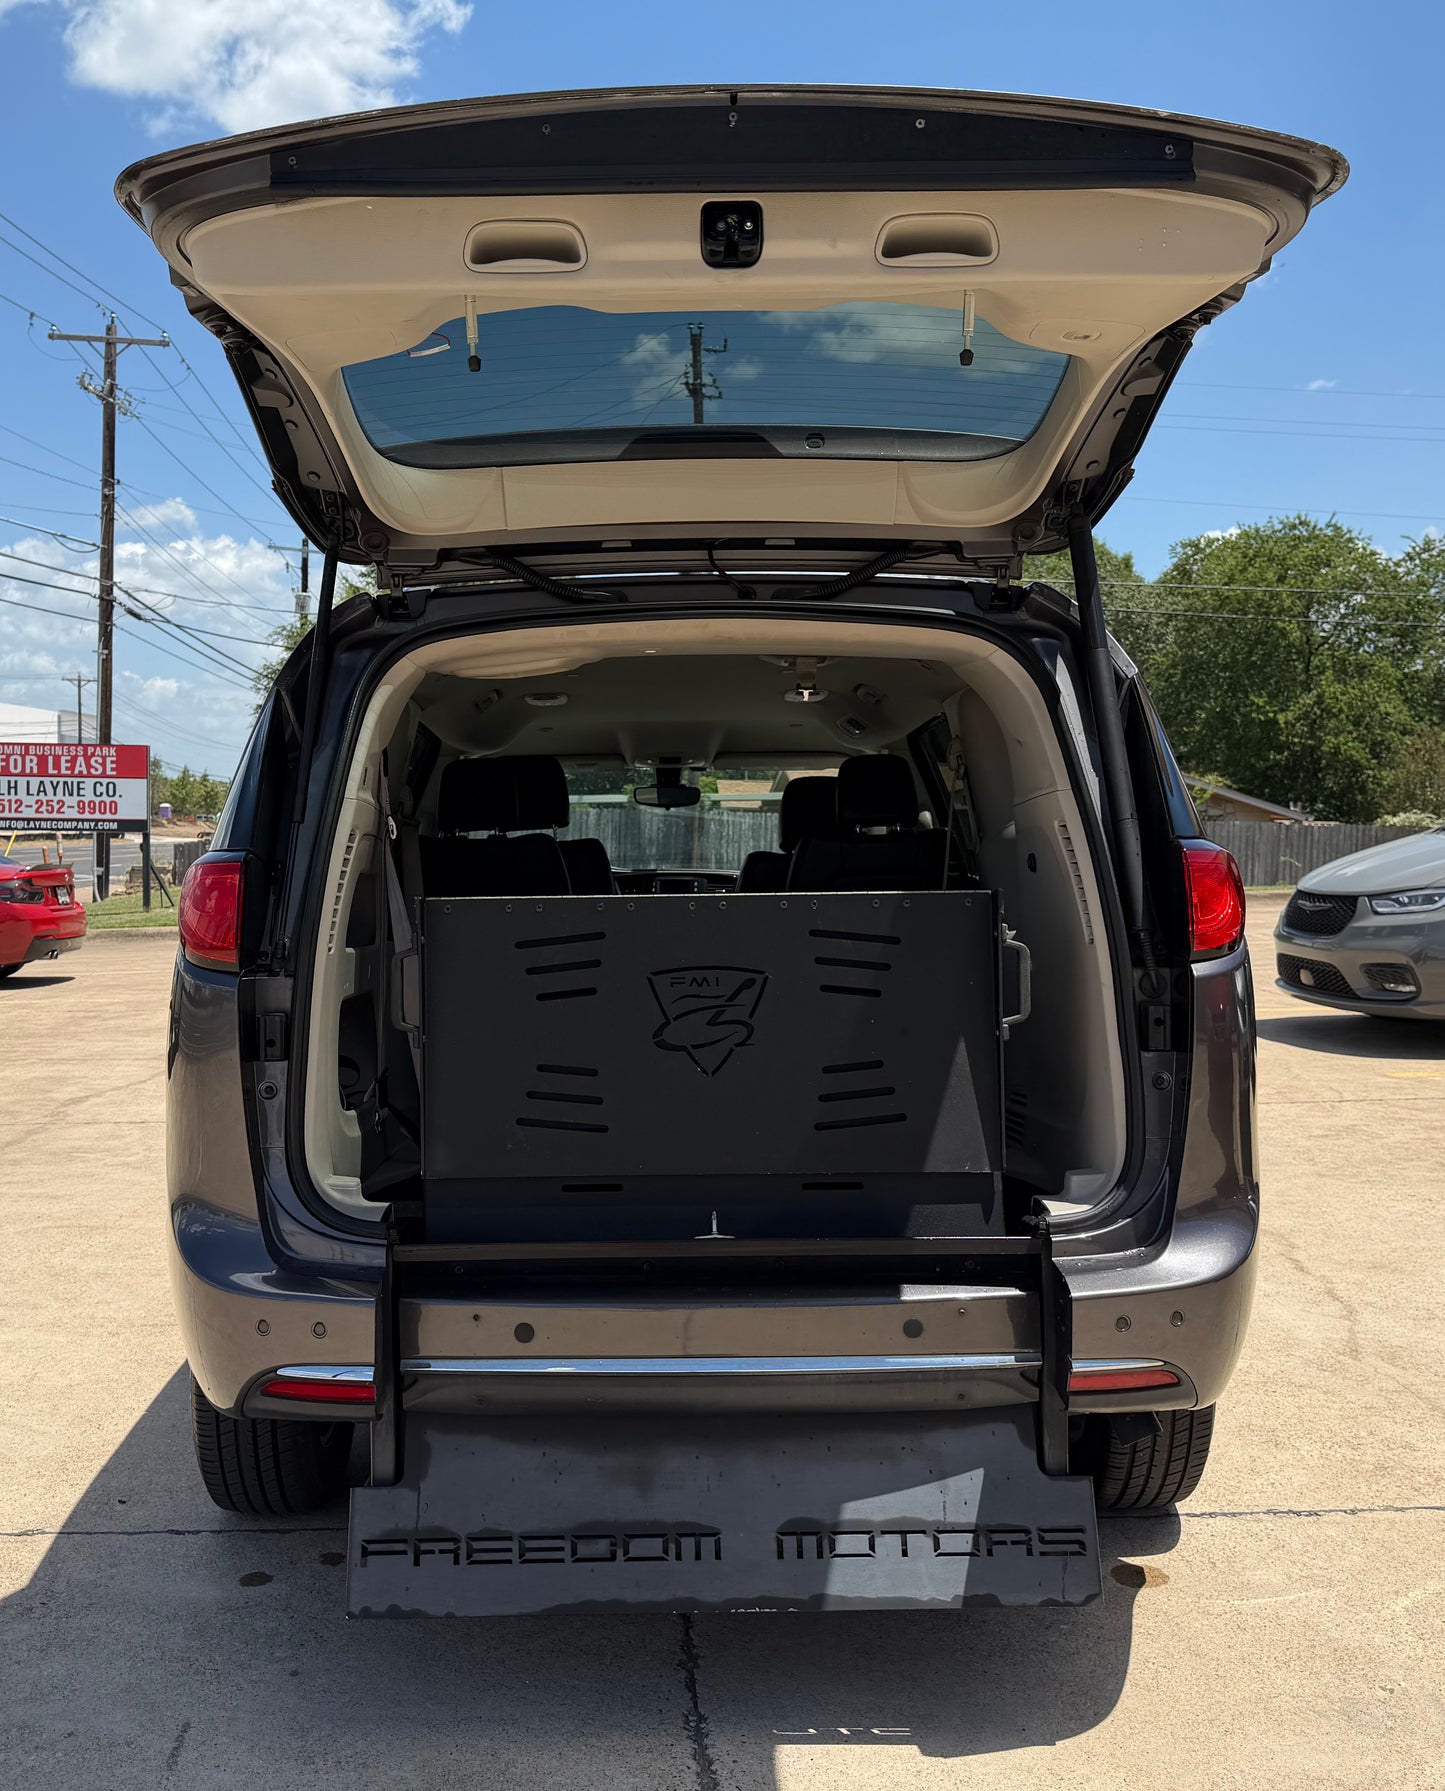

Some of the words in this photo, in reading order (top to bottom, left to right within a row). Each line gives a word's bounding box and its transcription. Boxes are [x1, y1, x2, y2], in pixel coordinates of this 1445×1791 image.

[29, 746, 84, 756] BUSINESS
[87, 747, 117, 757] PARK
[0, 754, 38, 774] FOR
[48, 755, 117, 776] LEASE
[0, 780, 18, 796] LH
[26, 780, 86, 798] LAYNE
[93, 781, 122, 798] CO.
[0, 798, 118, 815] 512-252-9900
[670, 976, 720, 987] FMI
[360, 1532, 722, 1568] FREEDOM
[776, 1527, 1088, 1560] MOTORS
